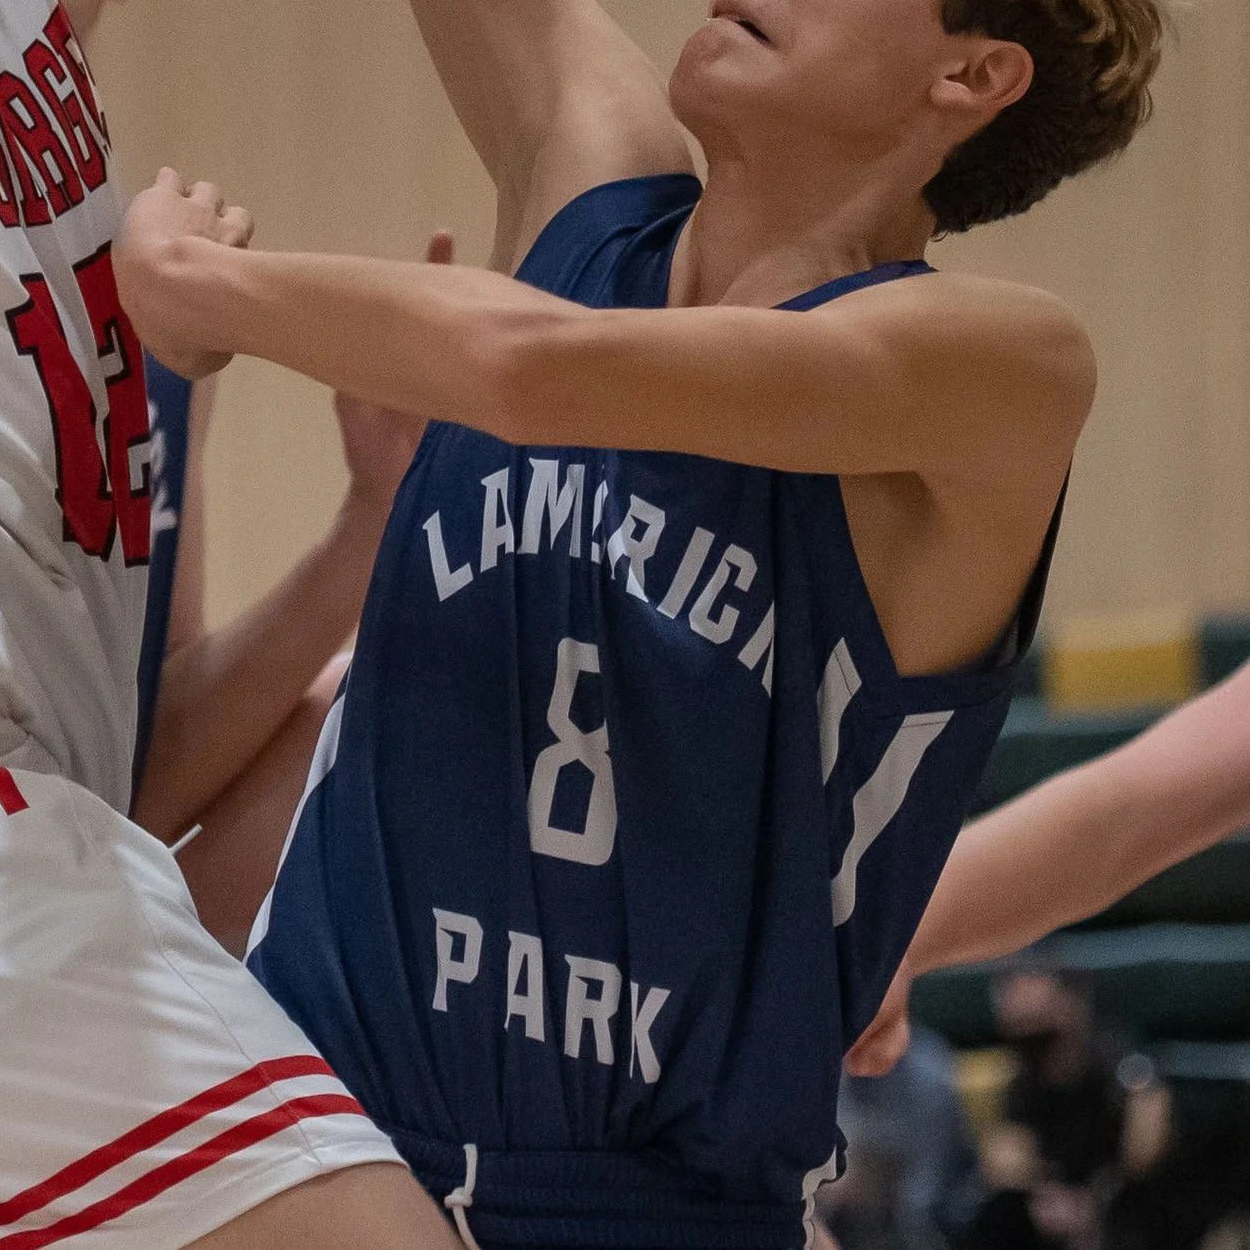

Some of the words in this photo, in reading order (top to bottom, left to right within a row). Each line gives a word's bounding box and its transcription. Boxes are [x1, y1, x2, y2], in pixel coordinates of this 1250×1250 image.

[4, 240, 151, 568] 12
[527, 636, 617, 866] 8
[432, 906, 671, 1084] PARK
